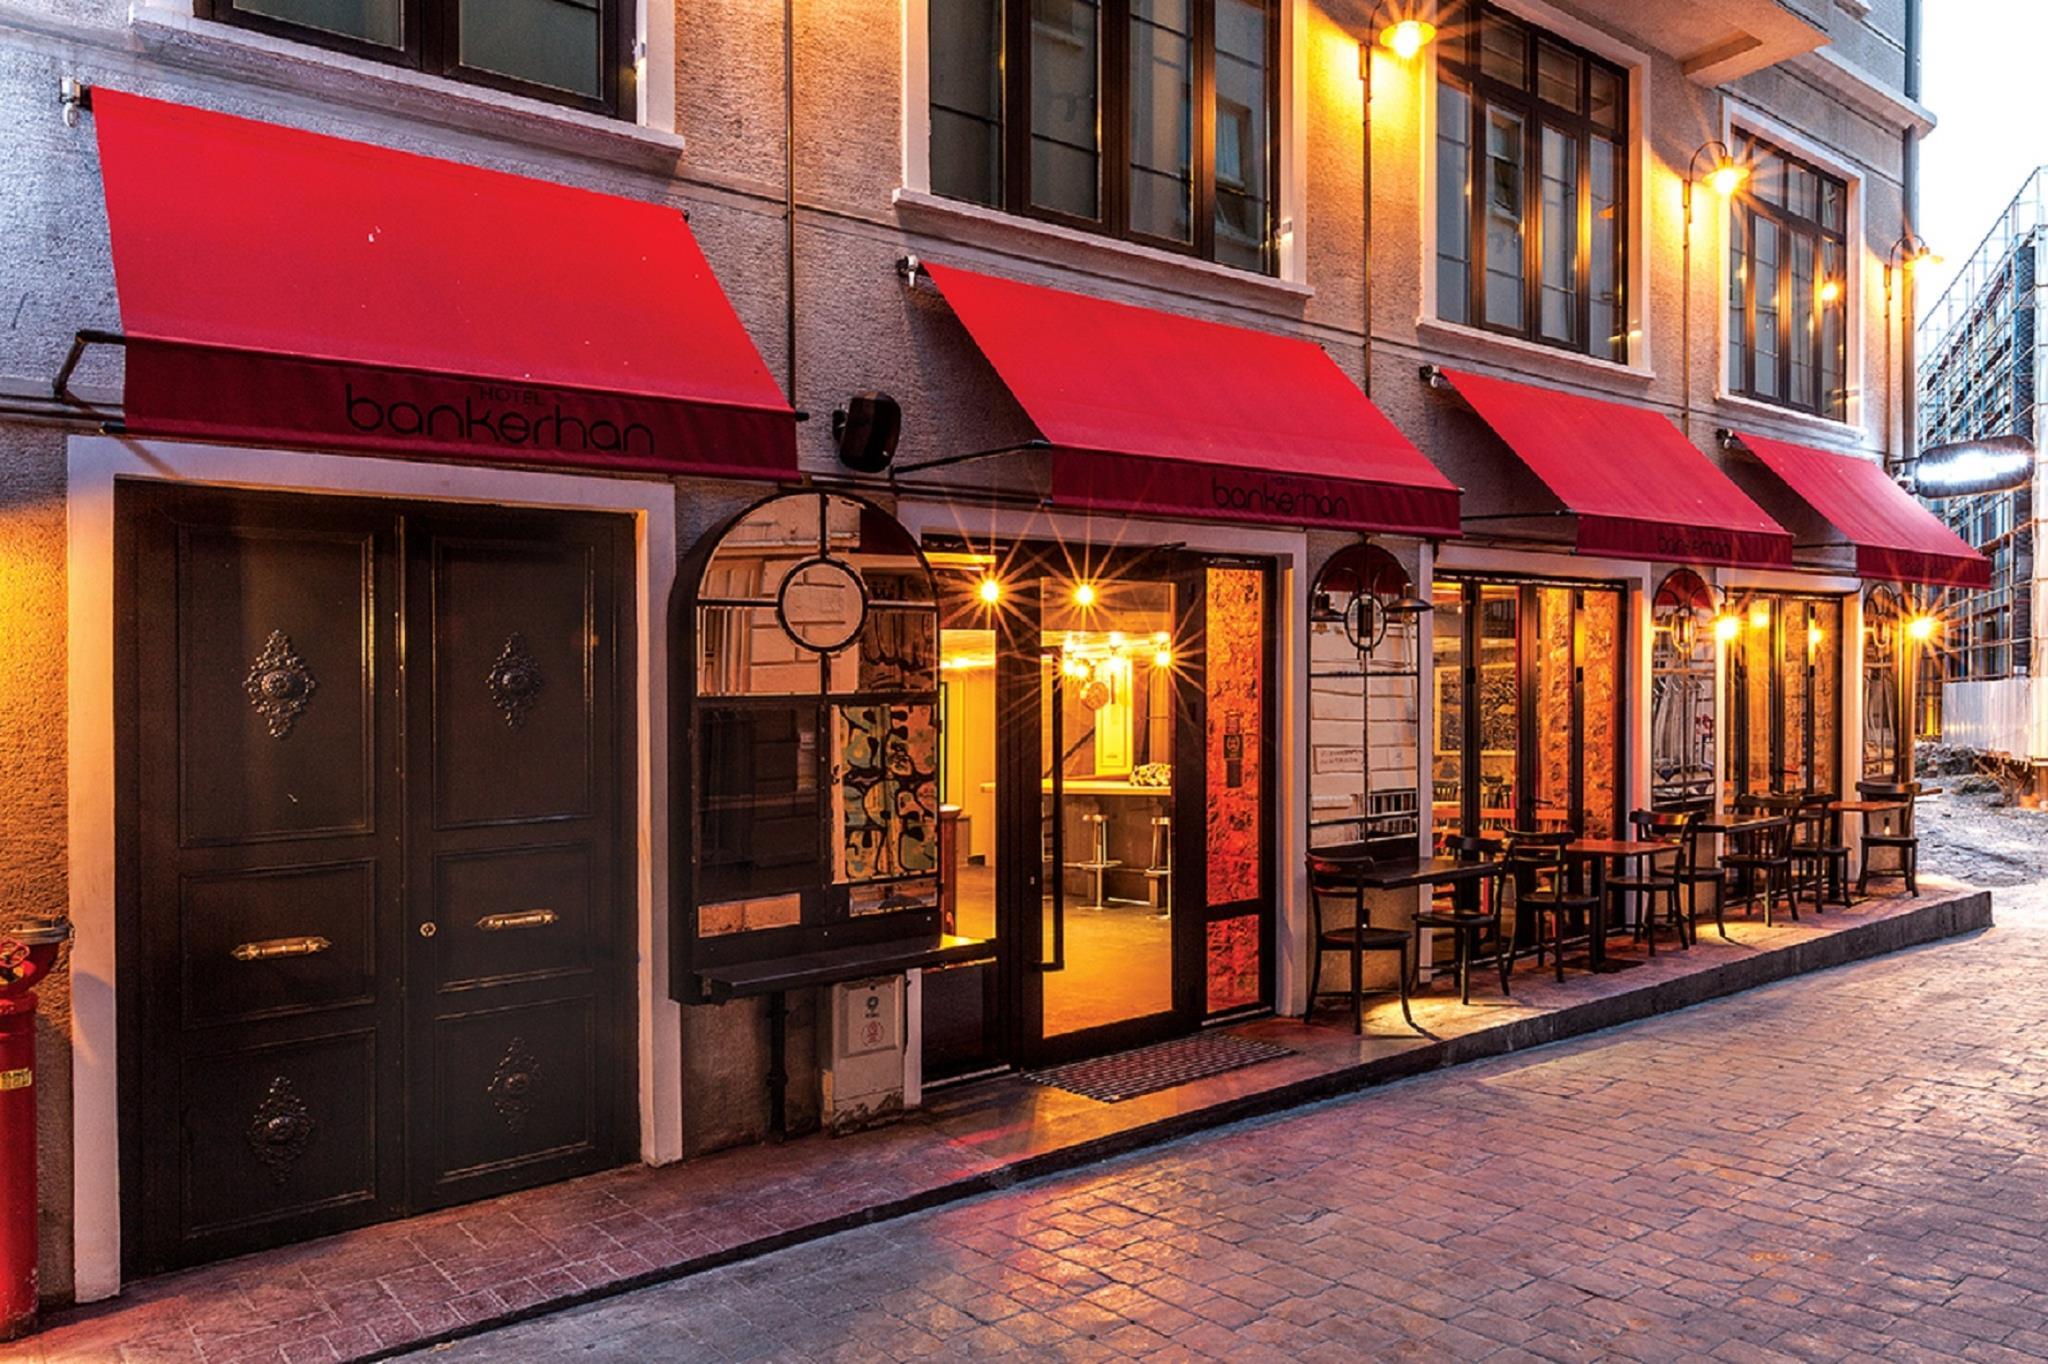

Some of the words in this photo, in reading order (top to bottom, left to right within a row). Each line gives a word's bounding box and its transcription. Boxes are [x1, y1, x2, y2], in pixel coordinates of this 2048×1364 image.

[480, 384, 544, 405] HOTEL
[345, 383, 655, 454] bankerhan
[1211, 475, 1349, 518] bankerhan
